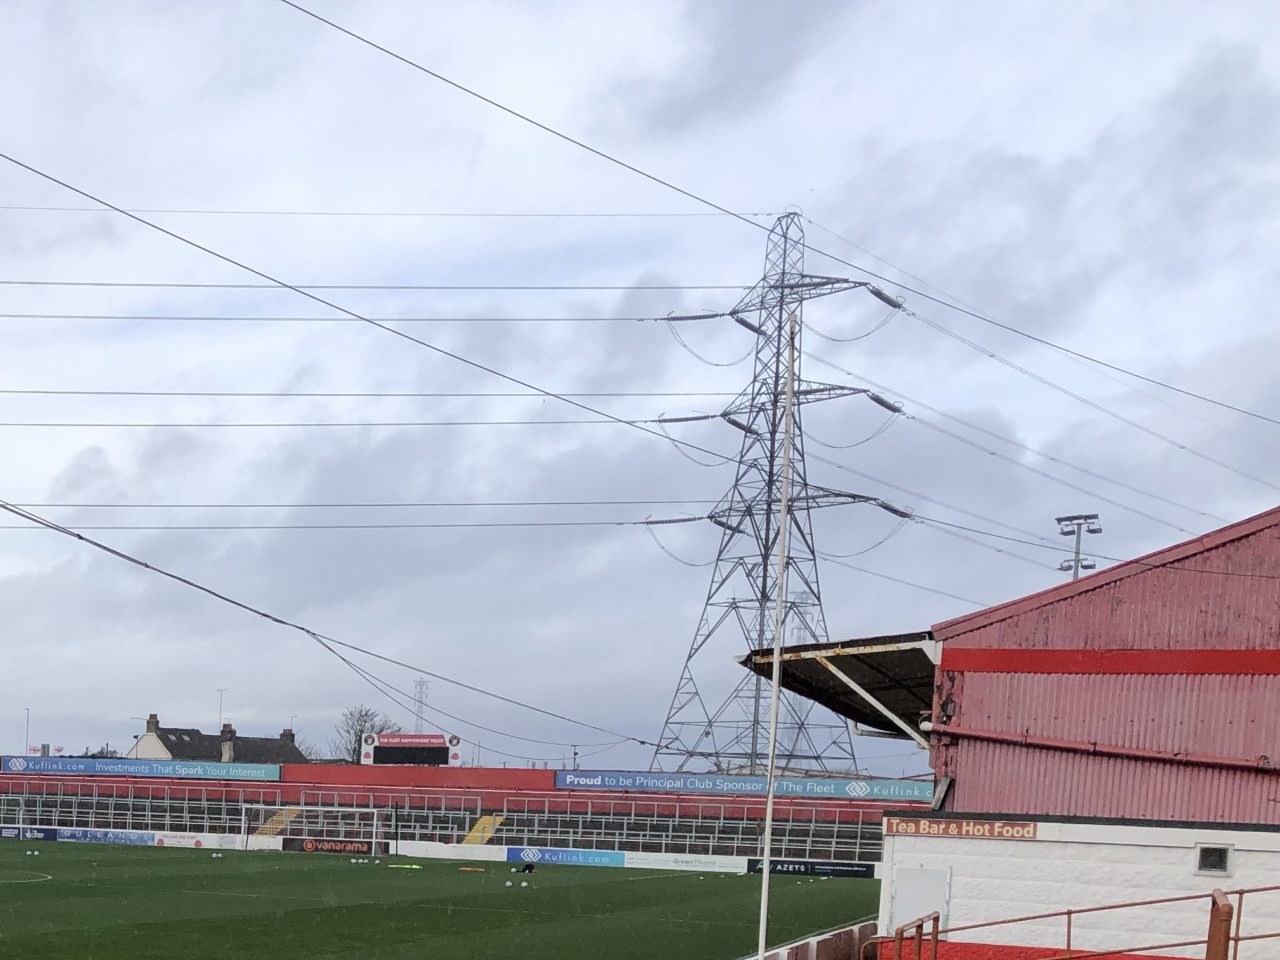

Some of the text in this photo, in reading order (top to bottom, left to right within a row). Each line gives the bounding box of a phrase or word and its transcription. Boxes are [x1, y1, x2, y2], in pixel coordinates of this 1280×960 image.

[28, 761, 265, 778] Kuflink.com Investments That Spark Your Interest
[566, 775, 602, 786] Proud
[605, 777, 616, 787] to
[619, 776, 633, 787] be
[636, 777, 684, 789] Principal
[687, 778, 713, 789] Club
[715, 780, 764, 792] Sponsor
[781, 781, 804, 793] The
[806, 782, 835, 794] Fleet
[890, 819, 1034, 838] Tea Bar & Hot Food
[63, 830, 153, 841] GULLANDS
[316, 842, 368, 852] vanarama
[544, 852, 609, 863] Kuflink.com
[776, 864, 806, 872] AZETS
